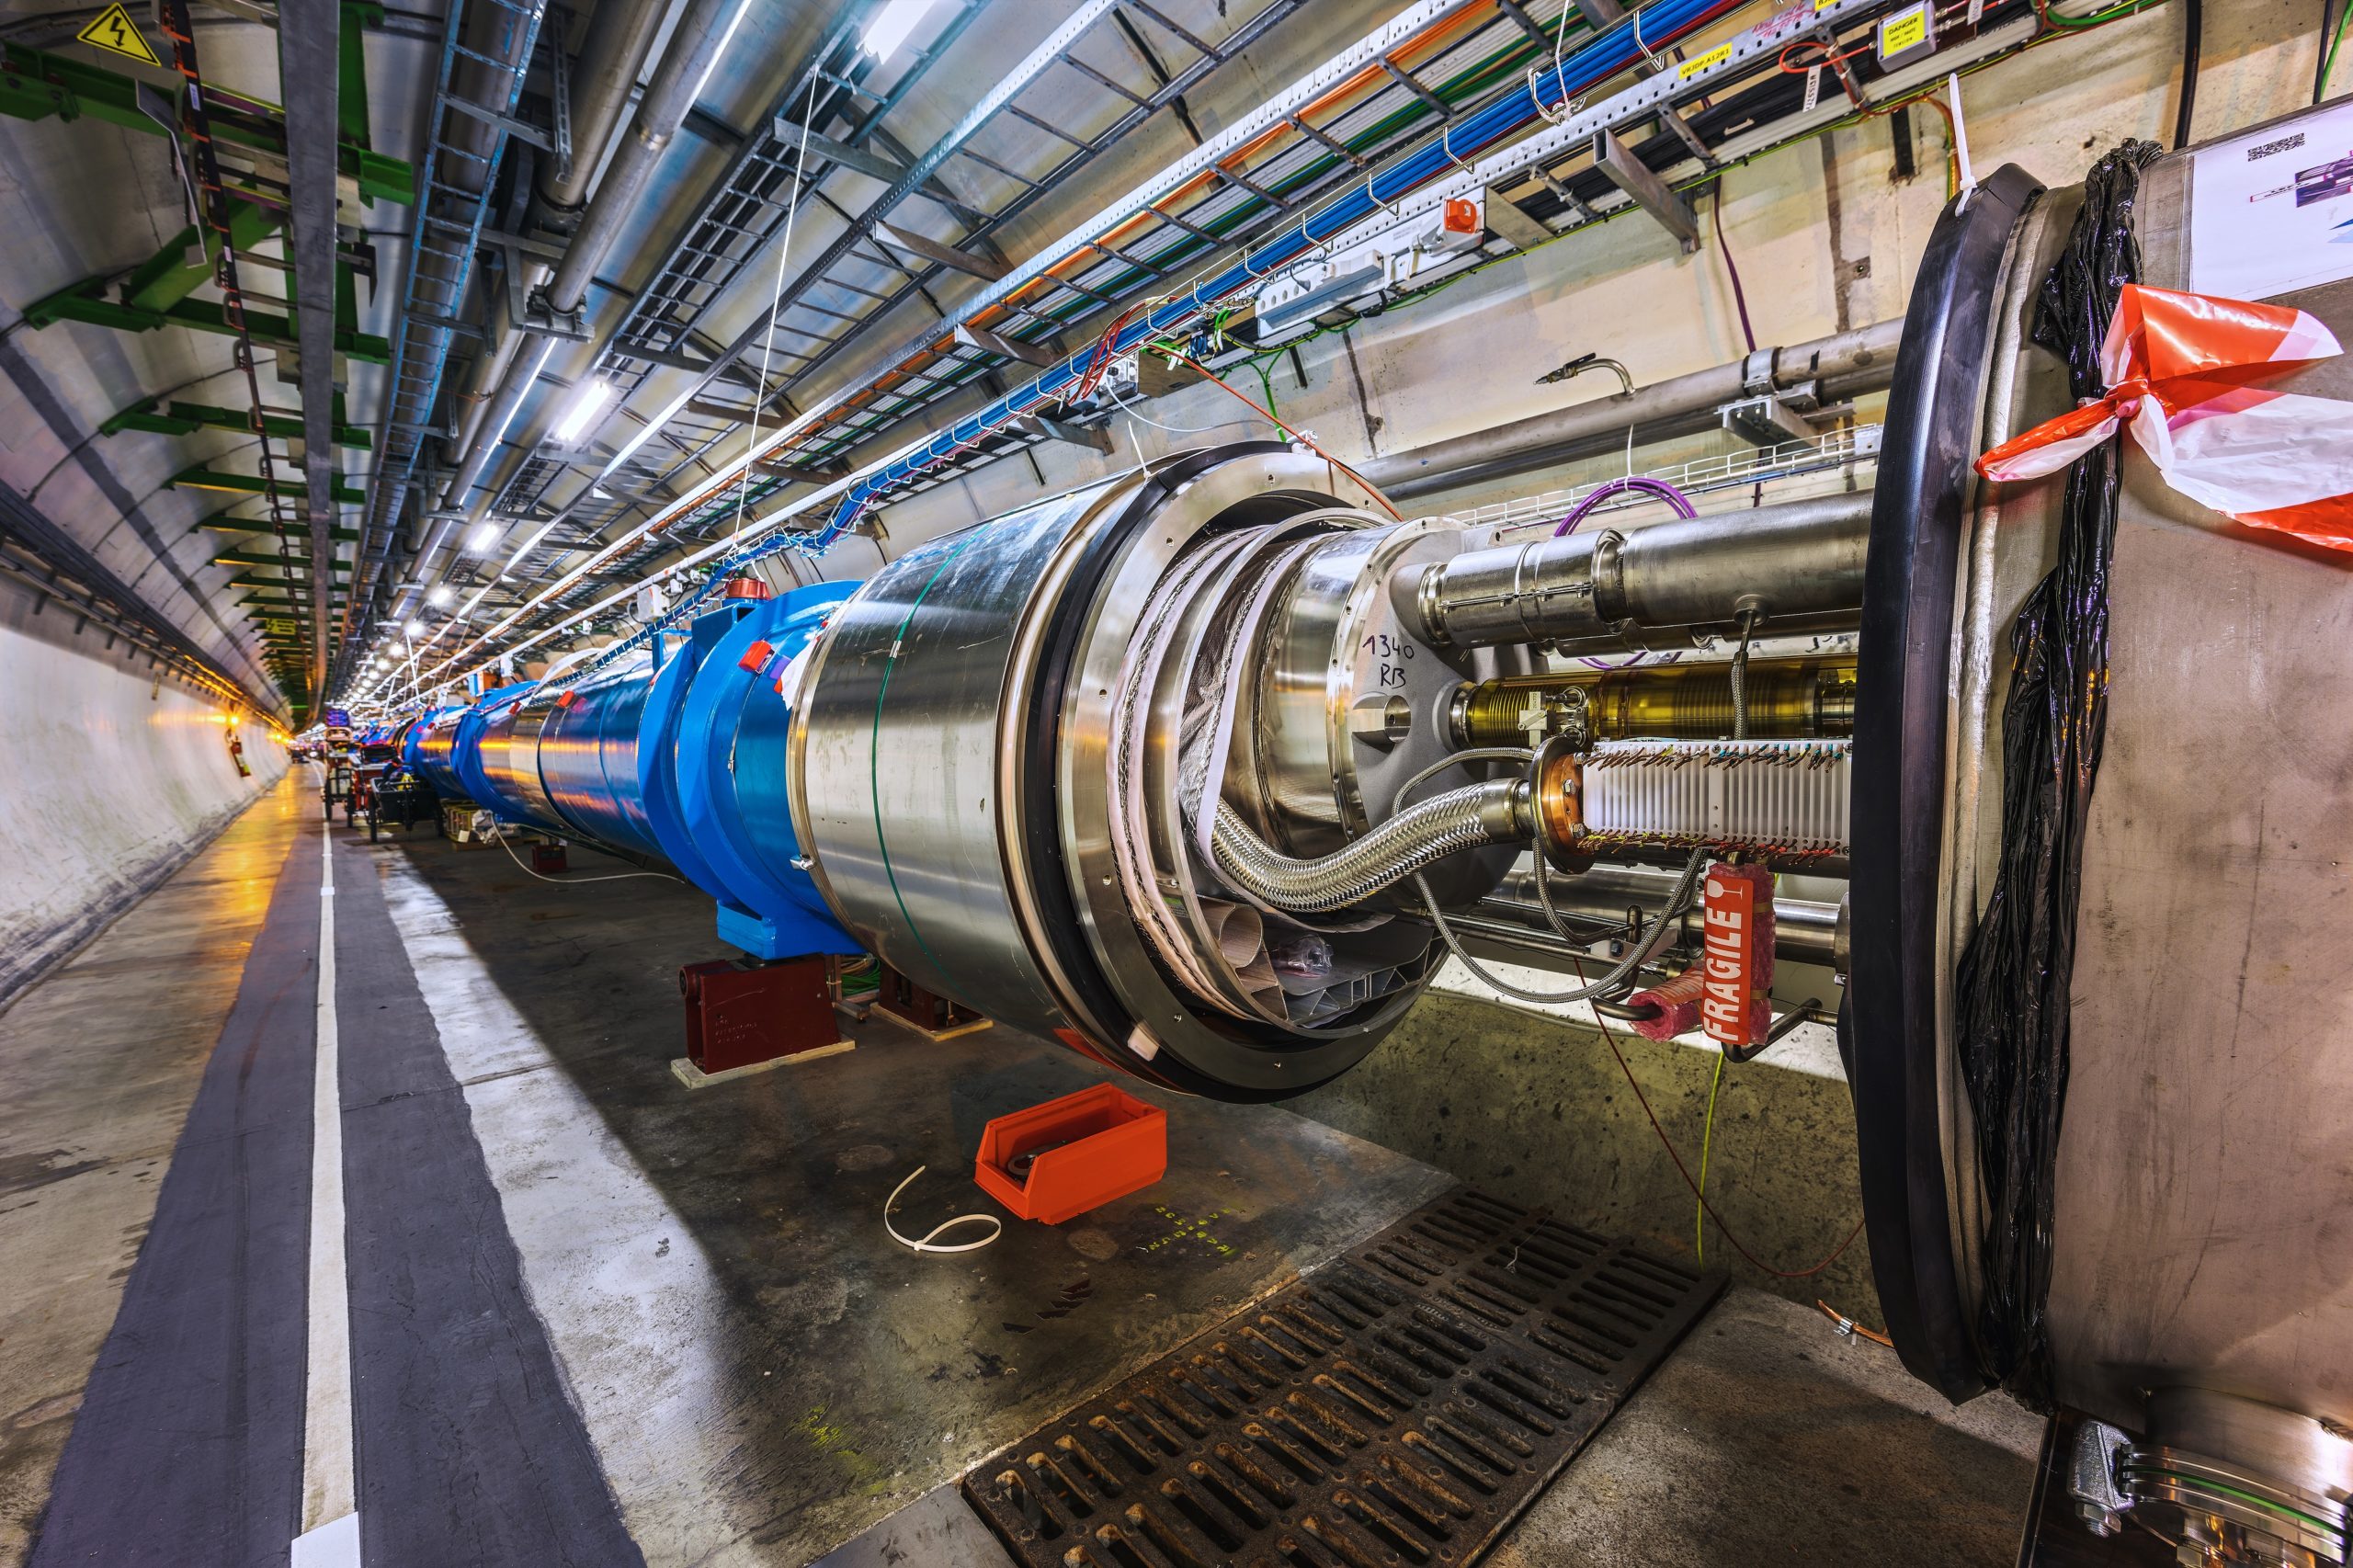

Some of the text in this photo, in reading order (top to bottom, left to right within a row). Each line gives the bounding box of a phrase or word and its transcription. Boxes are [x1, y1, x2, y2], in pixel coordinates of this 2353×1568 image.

[1889, 17, 1918, 35] DANGER
[1362, 634, 1415, 659] 1340
[1703, 906, 1742, 1042] FRAGILE
